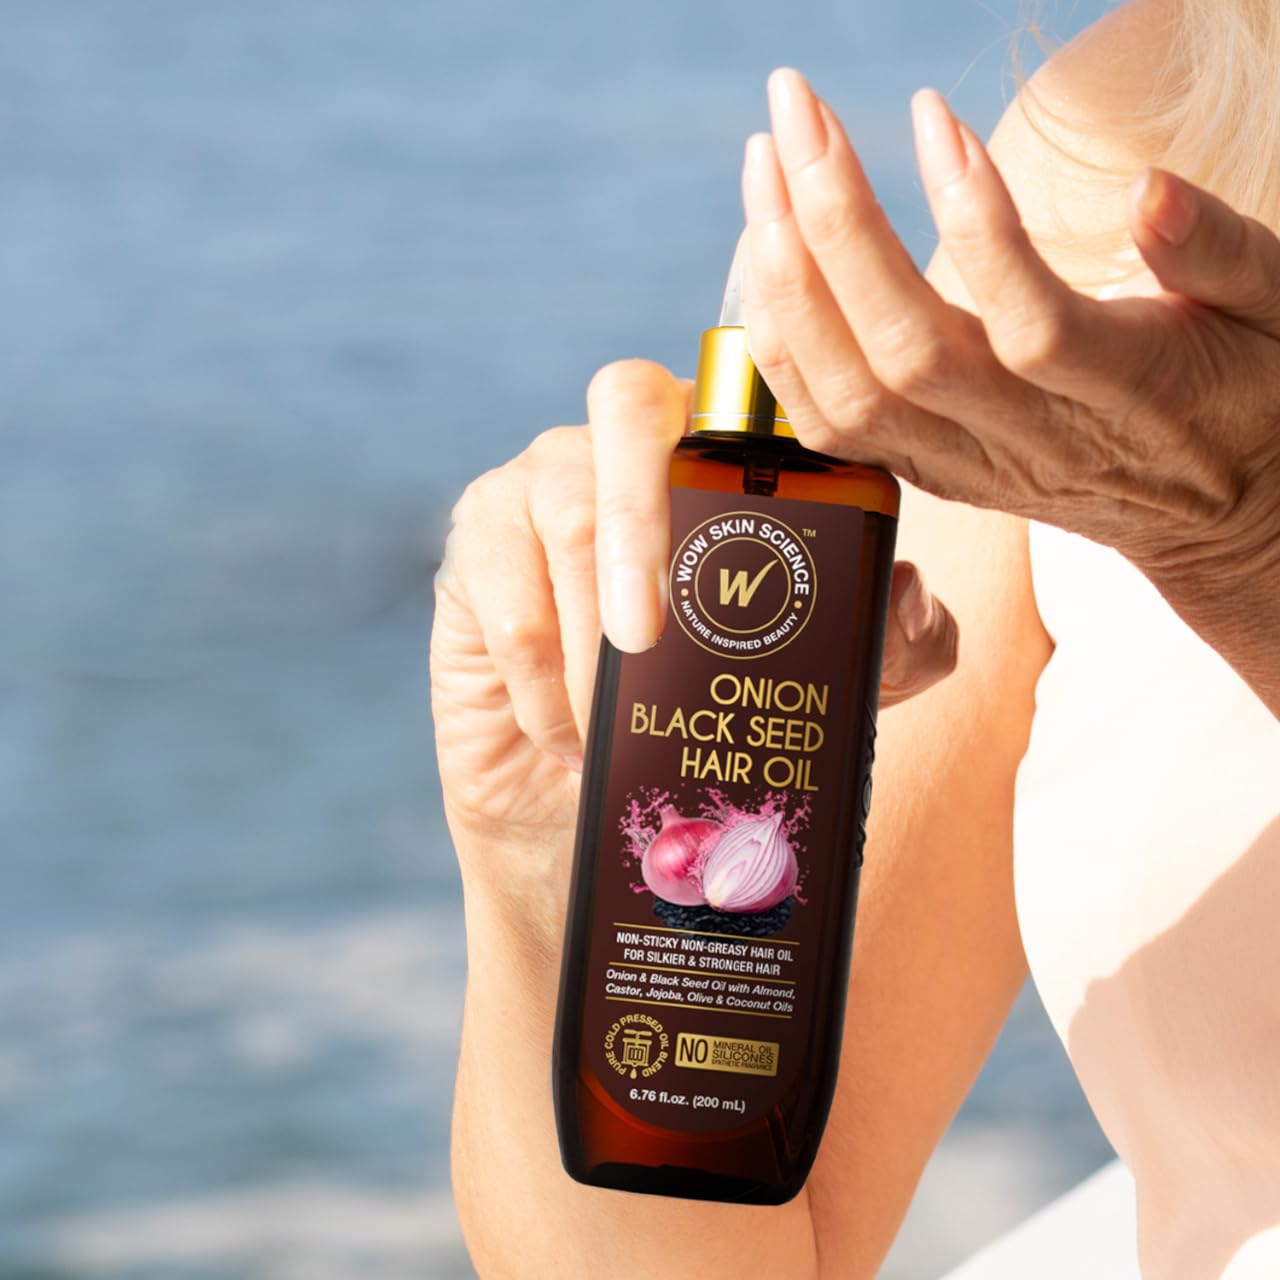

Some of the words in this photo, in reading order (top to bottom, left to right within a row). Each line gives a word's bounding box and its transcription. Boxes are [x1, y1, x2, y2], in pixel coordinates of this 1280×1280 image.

[676, 535, 708, 582] WOW
[709, 519, 755, 540] SKIN
[759, 523, 809, 595] SCIENCE
[681, 600, 712, 639] NATURE
[711, 634, 762, 650] INSPIRED
[763, 613, 798, 645] BEAUTY
[710, 673, 829, 716] ONION
[630, 702, 735, 744] BLACK
[747, 716, 824, 752] SEED
[680, 746, 752, 784] HAIR
[763, 756, 819, 791] OIL
[616, 932, 679, 949] NON-STICKY
[681, 940, 748, 956] NON-GREASY
[751, 946, 774, 959] HAIR
[777, 950, 794, 962] OIL
[624, 949, 644, 961] FOR
[647, 951, 685, 966] SILKIER
[688, 956, 696, 967] &
[699, 957, 753, 973] STRONGER
[755, 963, 780, 976] HAIR
[606, 969, 637, 982] Onion
[639, 973, 647, 983] &
[650, 974, 679, 986] Black
[681, 977, 709, 989] Seed
[711, 980, 726, 991] Oil
[729, 982, 750, 994] with
[752, 985, 796, 999] Almond,
[606, 983, 642, 998] Castor,
[646, 987, 684, 1002] Jojoba,
[687, 992, 713, 1004] Olive
[716, 995, 724, 1005] &
[726, 996, 771, 1010] Coconut
[773, 1001, 793, 1012] Oils
[604, 1022, 621, 1049] COLD
[619, 1014, 663, 1033] PRESSED
[658, 1033, 669, 1050] OIL
[679, 1038, 708, 1064] NO
[713, 1041, 755, 1053] MINERAL
[759, 1045, 774, 1055] OIL
[605, 1051, 627, 1075] PURE
[642, 1052, 668, 1078] BLEND
[712, 1050, 773, 1065] SILICONES
[629, 1088, 656, 1102] 6.76
[659, 1092, 689, 1105] fl.oz.
[692, 1096, 719, 1109] (200
[722, 1100, 746, 1114] mL)
